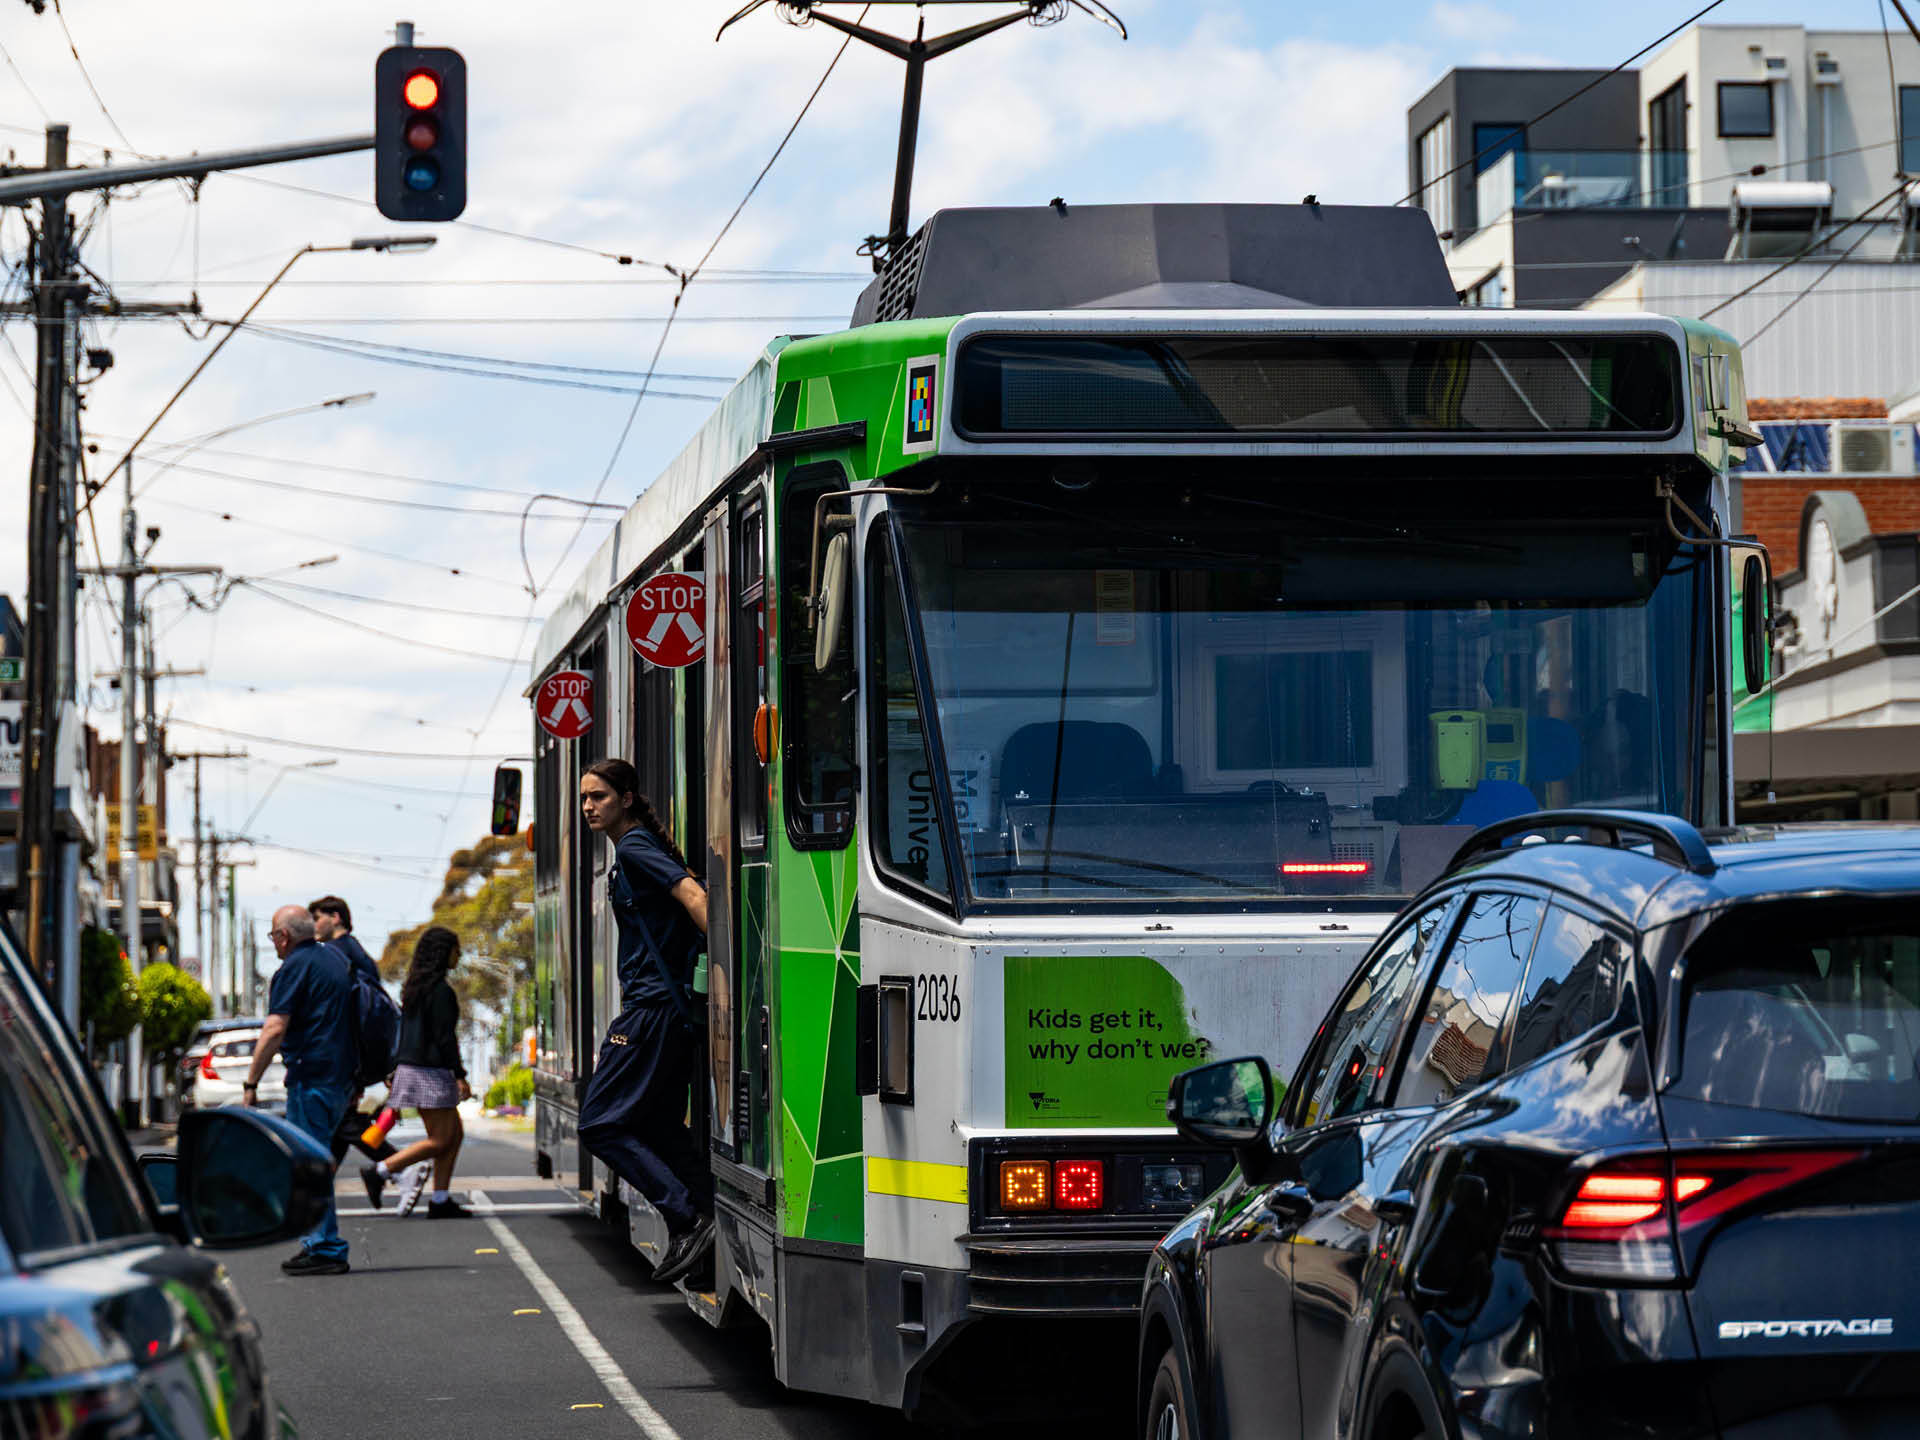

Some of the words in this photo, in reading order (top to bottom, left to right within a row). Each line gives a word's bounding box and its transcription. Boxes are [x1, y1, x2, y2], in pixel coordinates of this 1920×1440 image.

[641, 586, 704, 611] STOP
[547, 679, 591, 697] STOP
[950, 769, 978, 829] Mel
[917, 973, 961, 1022] 2036
[1028, 1007, 1082, 1028] Kids
[1089, 1009, 1131, 1034] get
[1138, 1007, 1163, 1032] it,
[1028, 1038, 1080, 1065] why
[1087, 1037, 1153, 1059] don’t
[1160, 1037, 1212, 1059] we?
[1718, 1317, 1894, 1339] SPORTAGE
